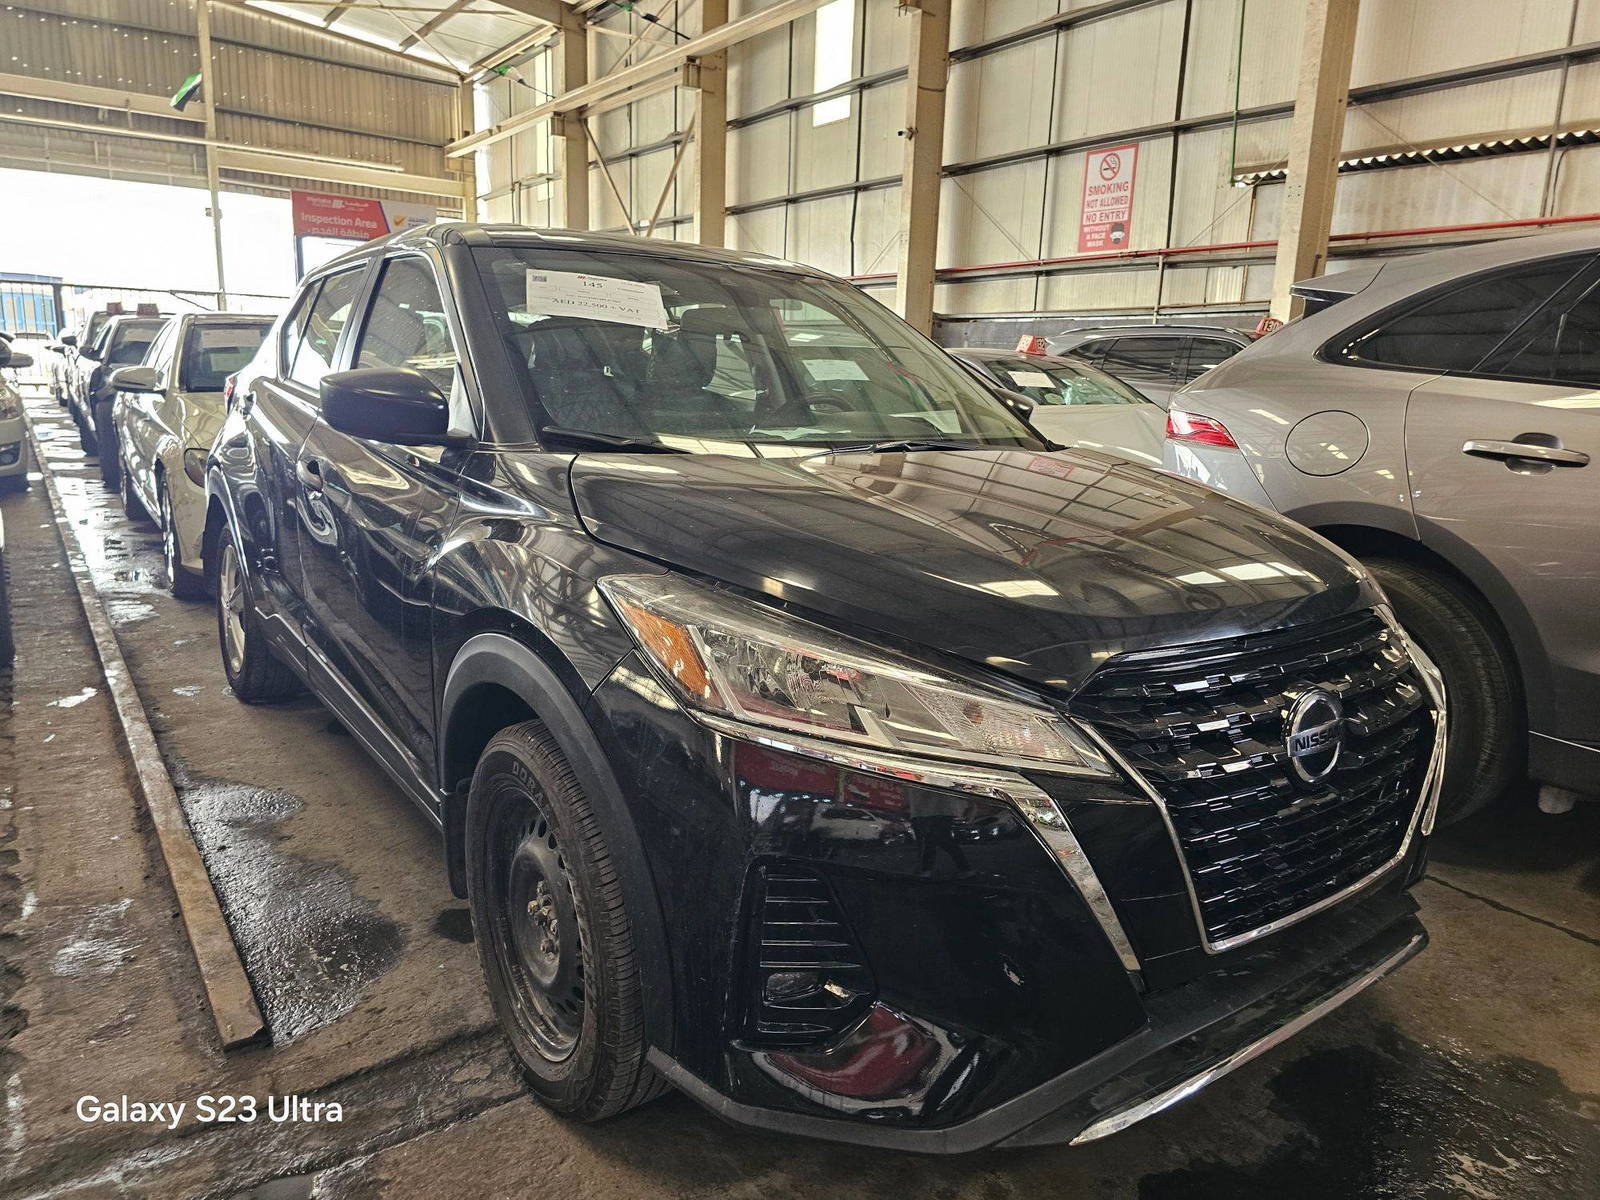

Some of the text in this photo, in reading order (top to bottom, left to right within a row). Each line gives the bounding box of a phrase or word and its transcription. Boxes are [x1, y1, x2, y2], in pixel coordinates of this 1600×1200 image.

[1088, 181, 1129, 196] SMOKING
[1086, 195, 1128, 209] NOT ALLOWED
[301, 212, 378, 229] Inspection Area
[1085, 208, 1126, 223] NO ENTRY
[582, 281, 603, 289] 145
[552, 297, 575, 305] AED
[618, 307, 640, 315] VAT
